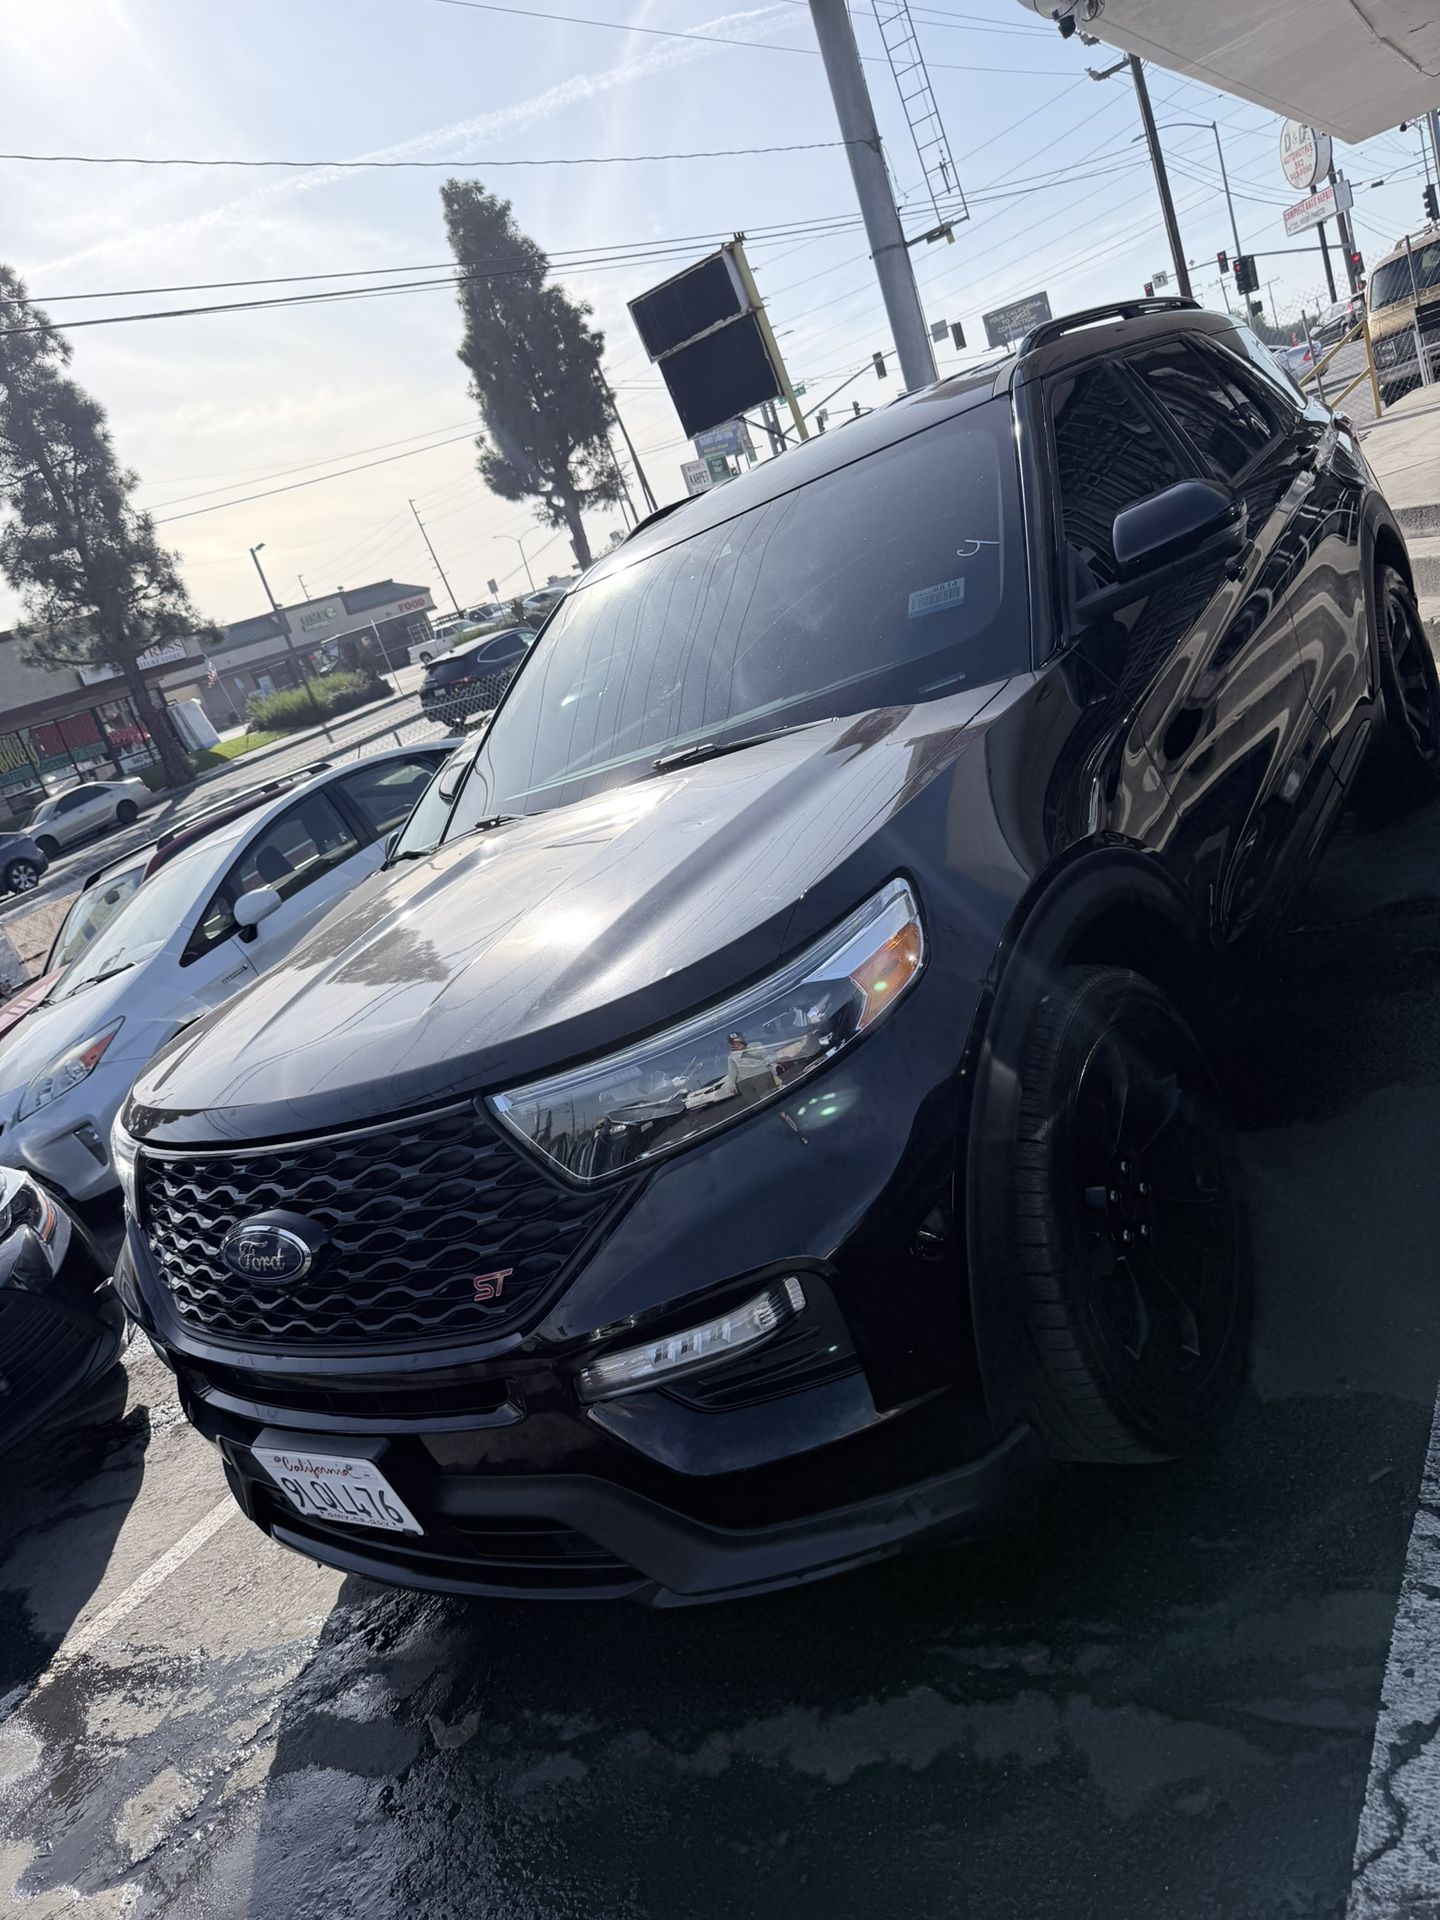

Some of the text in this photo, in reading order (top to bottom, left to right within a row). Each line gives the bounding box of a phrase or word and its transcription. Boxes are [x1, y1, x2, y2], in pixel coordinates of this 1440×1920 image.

[398, 598, 426, 613] FOOD
[238, 1240, 285, 1271] Ford
[474, 1267, 513, 1301] ST
[281, 1456, 352, 1479] California
